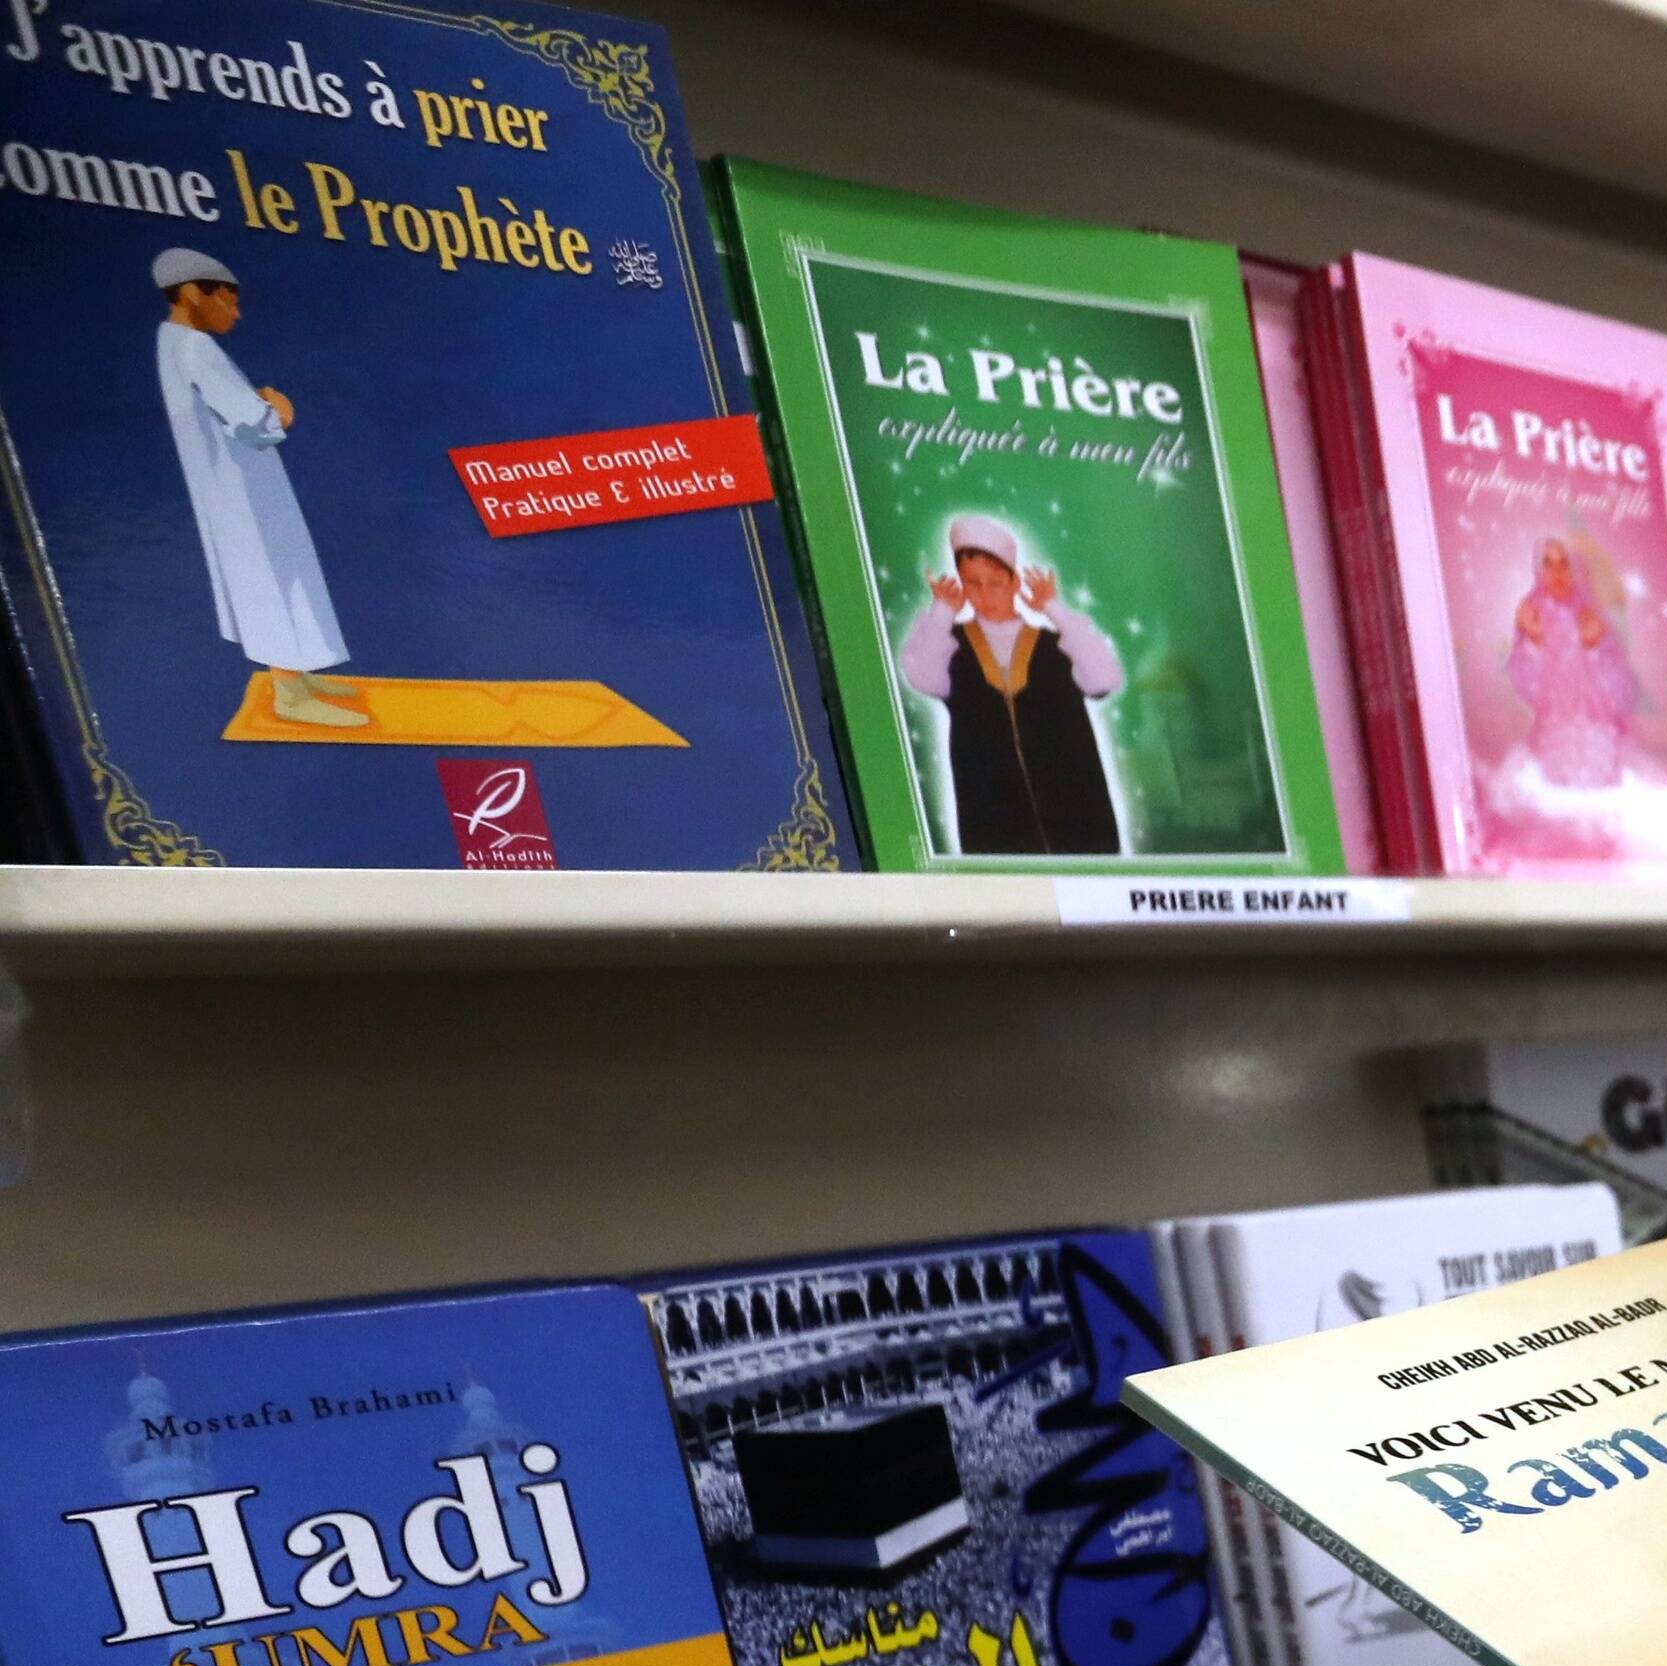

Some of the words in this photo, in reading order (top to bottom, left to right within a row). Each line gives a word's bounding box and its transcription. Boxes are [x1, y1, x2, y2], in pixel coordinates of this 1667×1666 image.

[363, 59, 405, 129] à
[412, 78, 549, 152] prier
[0, 141, 220, 222] omme
[226, 149, 299, 234] le
[304, 161, 594, 276] Prophète
[854, 331, 950, 397] La
[968, 348, 1184, 425] Prière
[464, 451, 573, 486] Manuel
[582, 437, 692, 472] complet
[878, 406, 1028, 466] expliquée
[1038, 424, 1058, 457] à
[1437, 394, 1499, 450] La
[1512, 410, 1648, 482] Prière
[482, 490, 602, 520] Pratique
[638, 467, 737, 501] illustré
[1129, 889, 1235, 913] PRIERE
[1242, 889, 1348, 913] ENFANT
[1438, 1253, 1487, 1290] TOUT
[1376, 1359, 1459, 1391] CHEIKH
[1453, 1348, 1499, 1371] ABD
[1492, 1320, 1599, 1360] AL-RAZZAQ
[1589, 1297, 1667, 1331] AL-BADR
[140, 1401, 295, 1442] Mostafa
[309, 1382, 457, 1421] Brahami
[1347, 1419, 1489, 1468] VOICI
[1478, 1383, 1600, 1435] VENU
[1594, 1366, 1660, 1398] LE
[62, 1442, 592, 1648] Hadj
